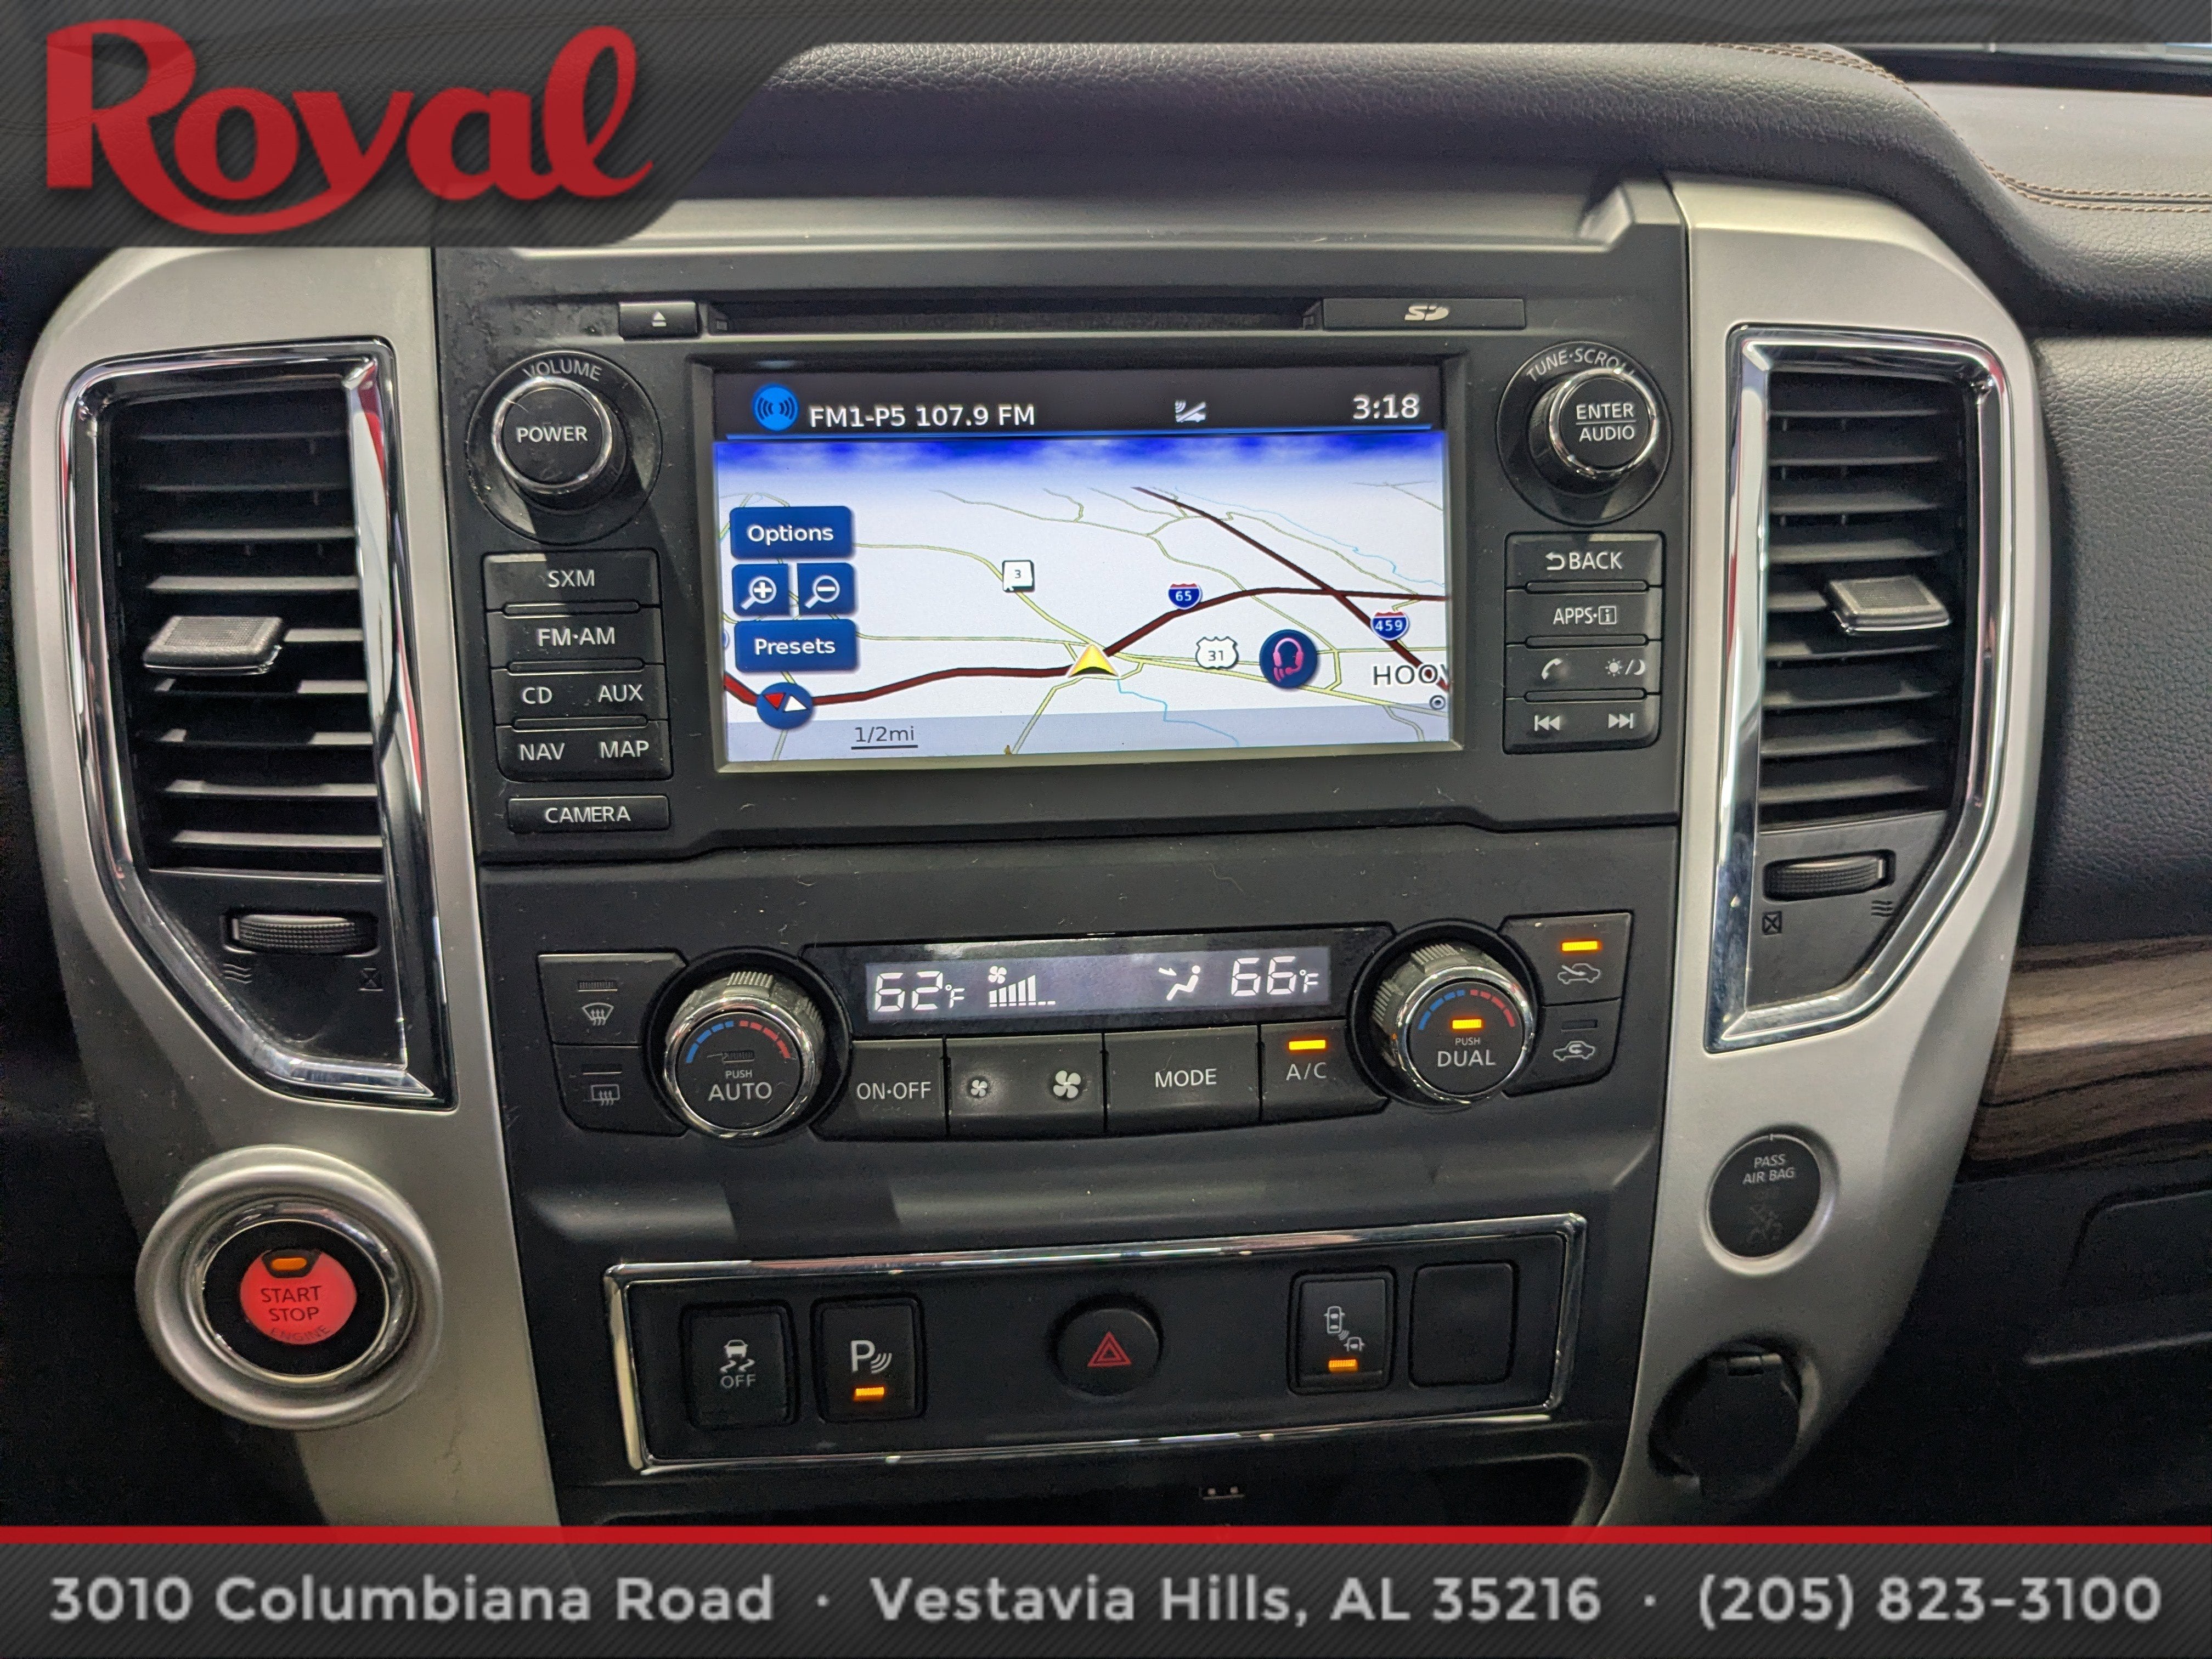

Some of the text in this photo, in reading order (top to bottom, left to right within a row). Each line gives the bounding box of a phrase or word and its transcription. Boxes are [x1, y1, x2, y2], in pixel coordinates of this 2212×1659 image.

[521, 359, 602, 381] VOLUME
[1352, 393, 1419, 419] 3:18
[1576, 403, 1634, 420] ENTER
[809, 403, 1035, 427] FM1-P5 107.9 FM
[516, 426, 588, 443] POWER
[1579, 426, 1635, 442] AUDIO
[747, 524, 834, 545] Options
[1569, 552, 1623, 569] BACK
[548, 569, 595, 588] SXM
[1014, 569, 1021, 578] 3
[1176, 590, 1192, 602] 65
[1374, 619, 1403, 632] 459
[755, 637, 836, 655] Presets
[1208, 651, 1224, 661] 31
[521, 685, 644, 704] CD AUX
[855, 726, 915, 743] 1/2mi
[520, 741, 649, 760] NAV MAP
[545, 806, 631, 823] CAMERA
[1455, 1037, 1480, 1046] PUSH
[1437, 1049, 1496, 1068] DUAL
[725, 1069, 753, 1079] PUSH
[1155, 1068, 1217, 1088] MODE
[1286, 1062, 1327, 1081] A/C
[709, 1082, 772, 1102] AUTO
[1754, 1154, 1786, 1169] PASS
[1742, 1167, 1796, 1184] AIR BAG
[261, 1285, 321, 1303] START
[268, 1307, 319, 1322] STOP
[720, 1374, 756, 1389] OFF
